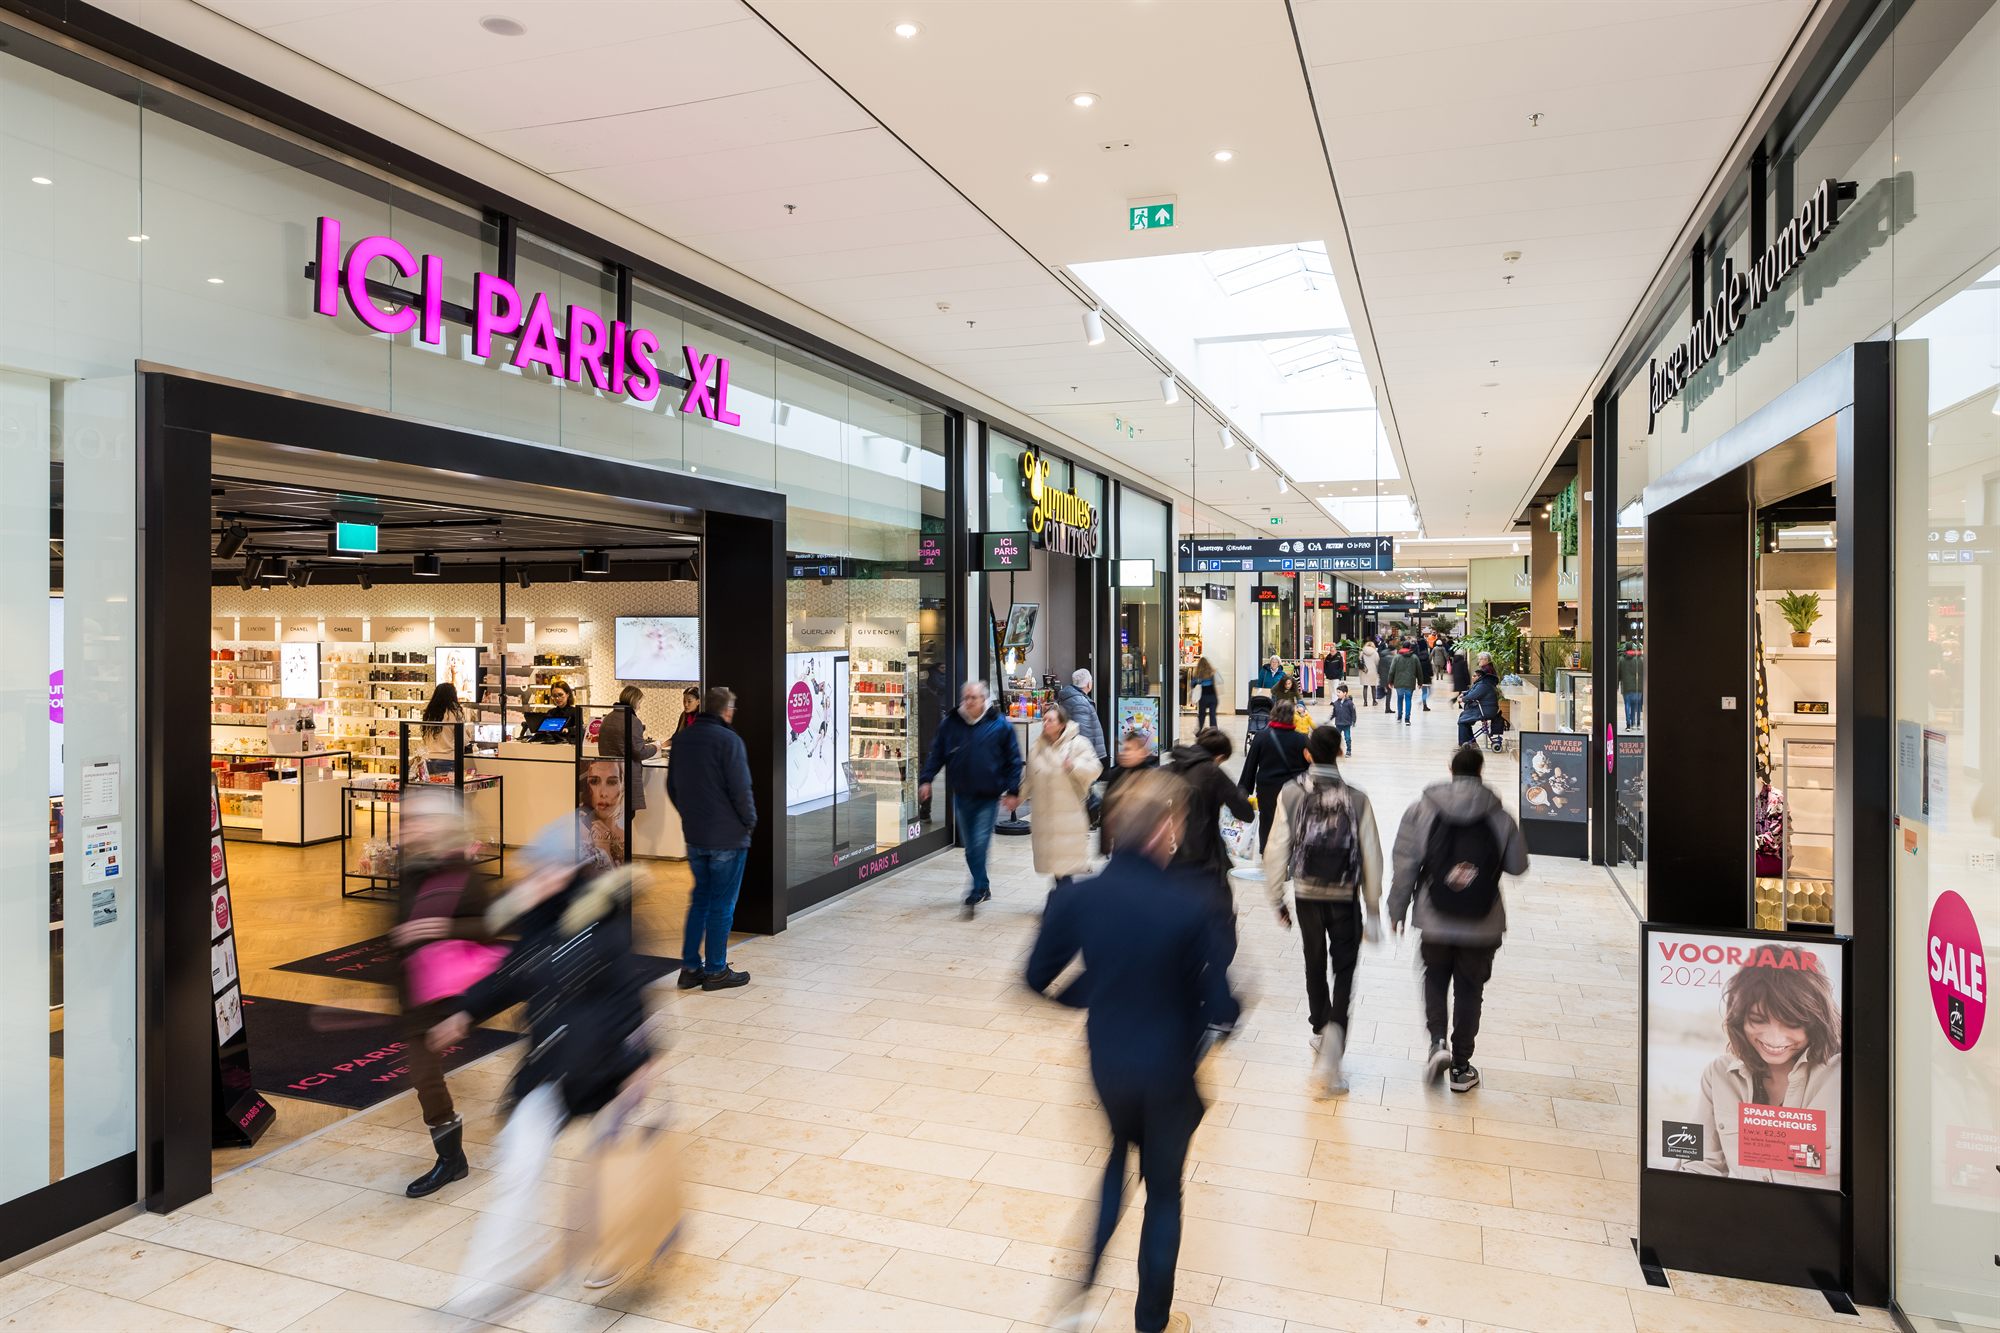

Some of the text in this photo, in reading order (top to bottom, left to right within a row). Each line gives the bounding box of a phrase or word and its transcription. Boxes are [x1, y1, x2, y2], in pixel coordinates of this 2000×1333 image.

[1686, 257, 1747, 378] mode
[1747, 178, 1840, 311] women
[313, 216, 741, 427] ICI PARIS XL
[1023, 451, 1091, 534] Yummies
[994, 547, 1018, 555] PARIS
[1000, 538, 1012, 546] ICI
[1001, 556, 1012, 564] XL
[790, 692, 810, 707] -35%
[858, 865, 869, 879] ICI
[869, 855, 889, 875] PARIS
[890, 851, 900, 864] XL
[1658, 941, 1818, 972] VOORJAAR
[1660, 965, 1724, 988] 2024
[1930, 935, 1983, 1004] SALE
[288, 1041, 410, 1090] ICI PARIS
[239, 1117, 250, 1128] ICI
[245, 1105, 260, 1121] PARIS
[1743, 1107, 1813, 1121] SPAAR GRATIS
[1743, 1117, 1817, 1132] MODECHEQUES
